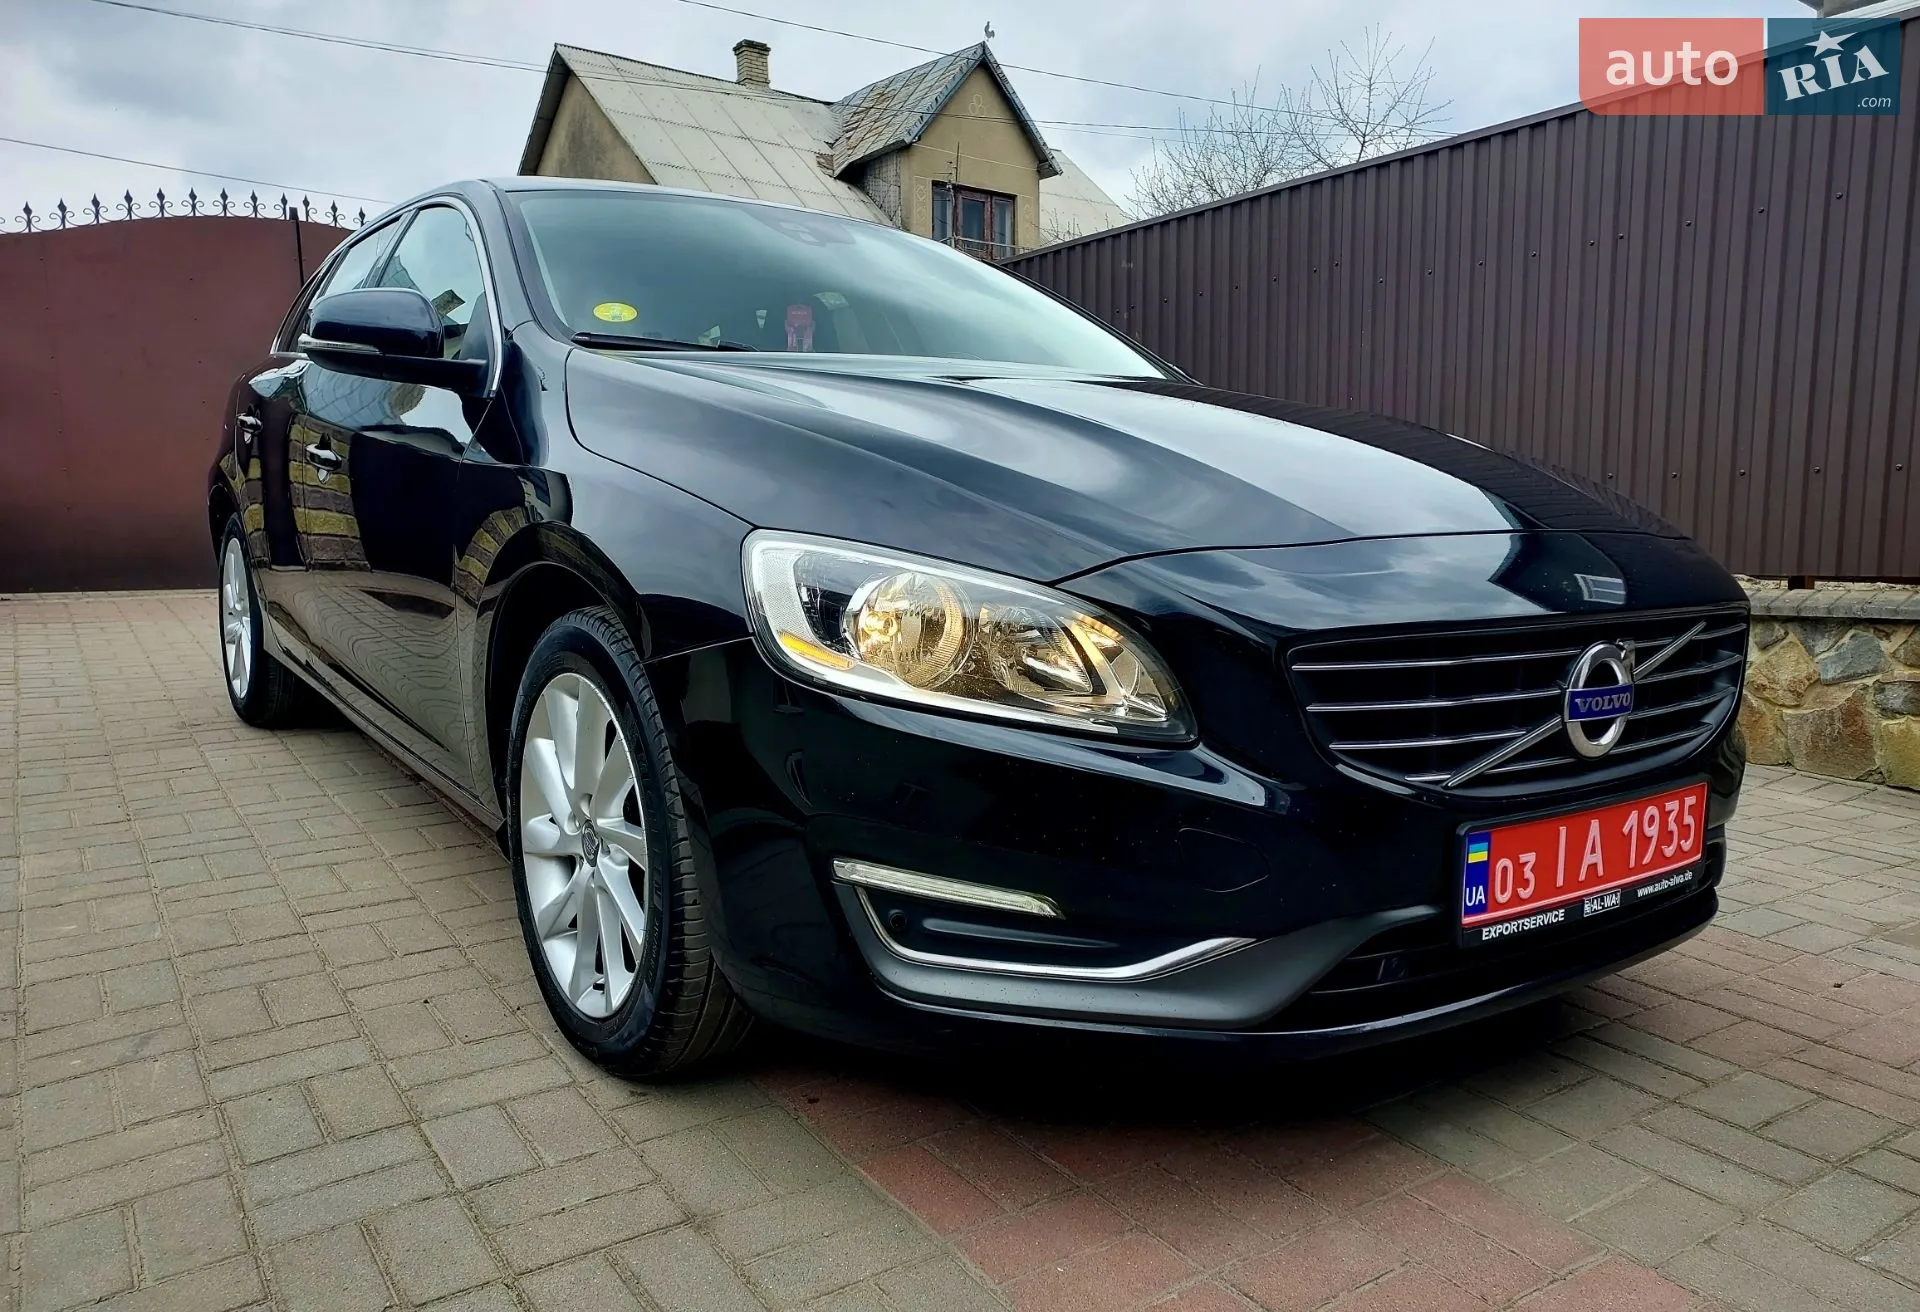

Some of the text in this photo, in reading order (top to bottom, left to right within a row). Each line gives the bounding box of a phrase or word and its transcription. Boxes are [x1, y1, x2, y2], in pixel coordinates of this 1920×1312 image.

[1574, 692, 1631, 713] VOLVO
[1494, 795, 1697, 904] 03 IA 1935
[1465, 884, 1486, 907] UA
[1481, 908, 1565, 941] EXPORTSERVICE
